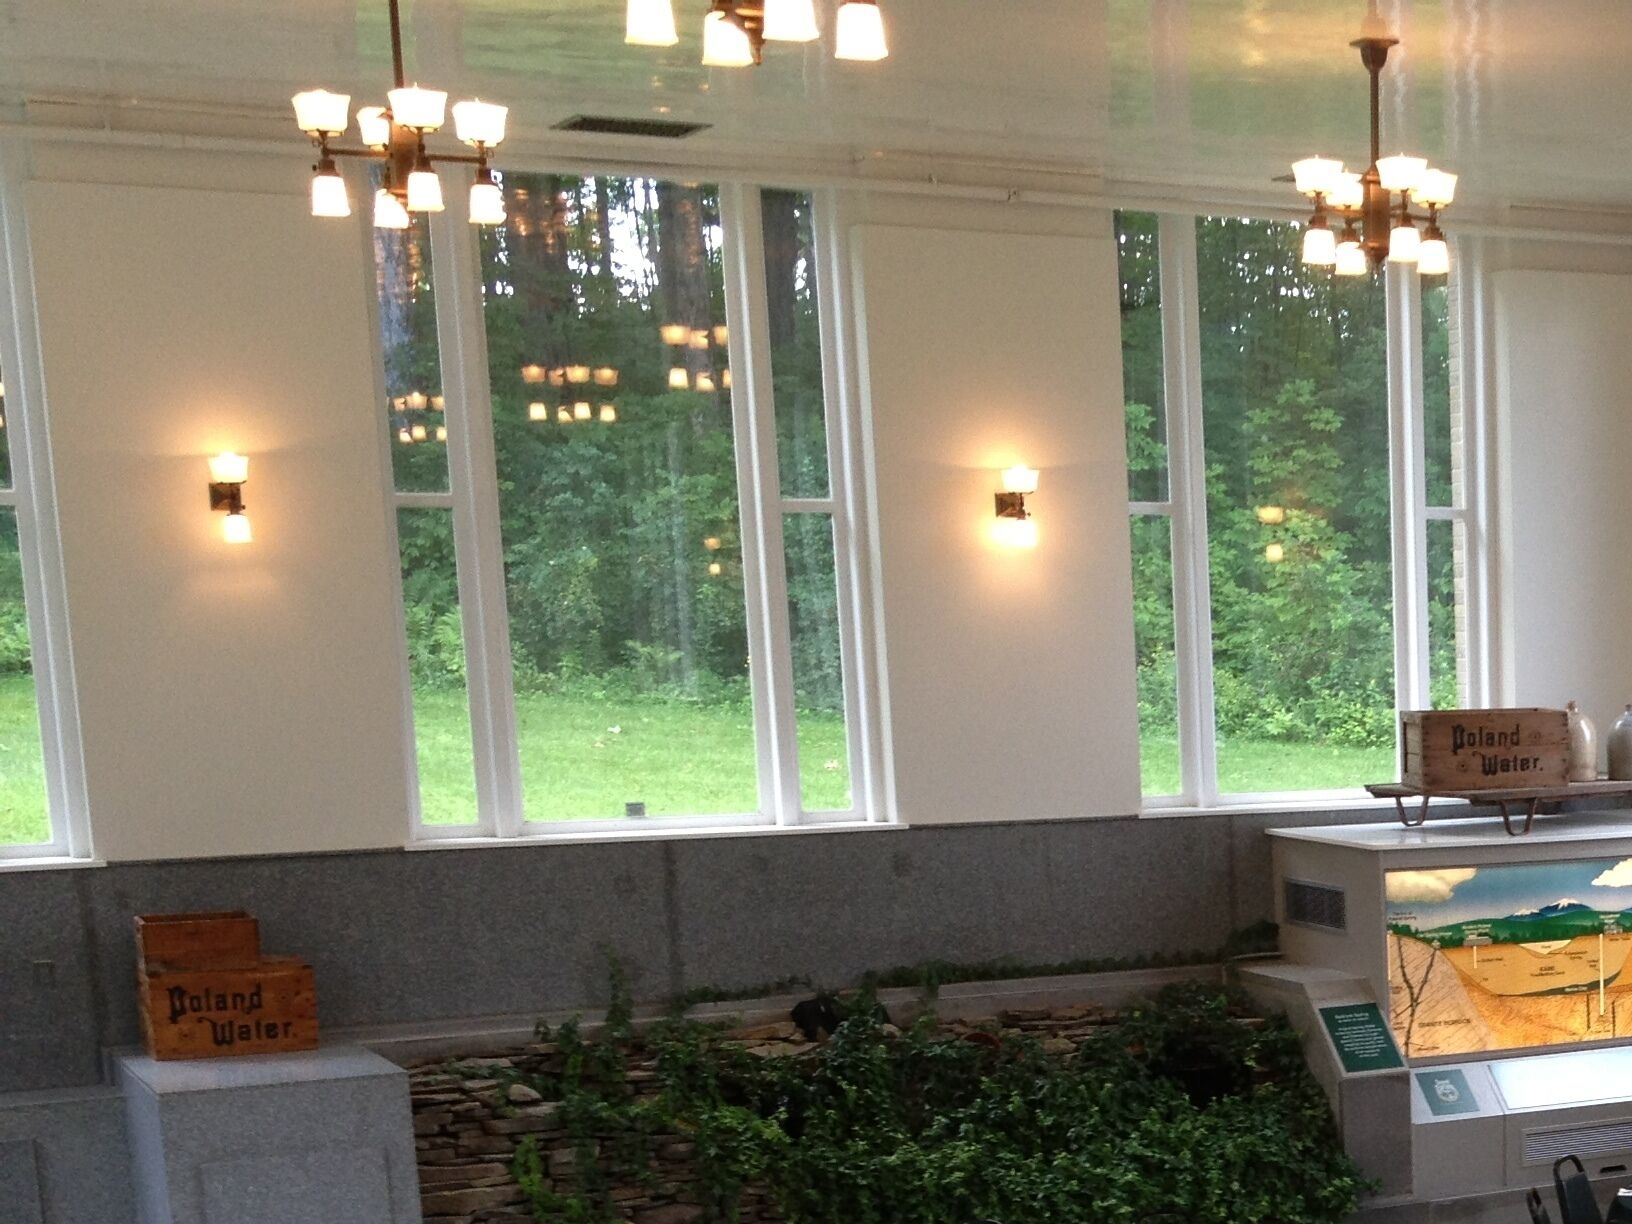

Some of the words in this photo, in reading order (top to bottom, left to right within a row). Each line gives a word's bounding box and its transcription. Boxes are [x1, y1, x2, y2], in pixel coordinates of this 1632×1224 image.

[1452, 723, 1520, 755] Poland
[1472, 751, 1544, 776] Water.
[166, 982, 262, 1024] Poland
